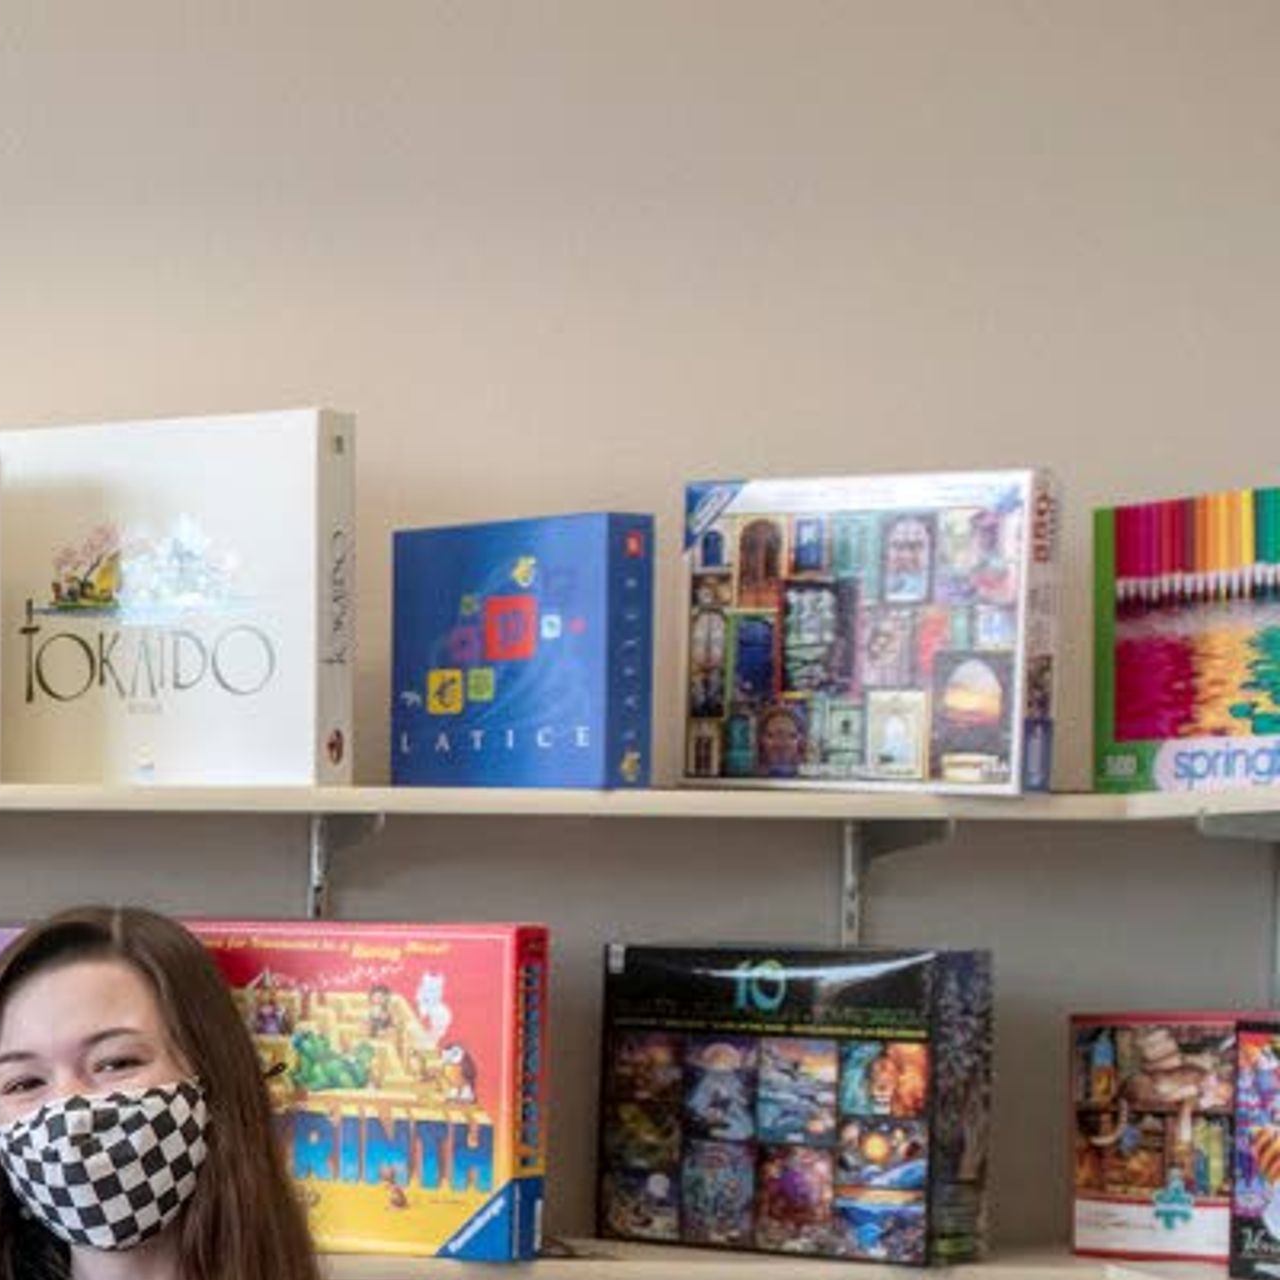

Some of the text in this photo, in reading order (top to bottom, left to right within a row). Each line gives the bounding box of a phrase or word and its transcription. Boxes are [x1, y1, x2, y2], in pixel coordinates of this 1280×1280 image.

[20, 599, 276, 703] TOKAIDO
[400, 726, 591, 754] LATICE
[734, 958, 788, 1014] 10
